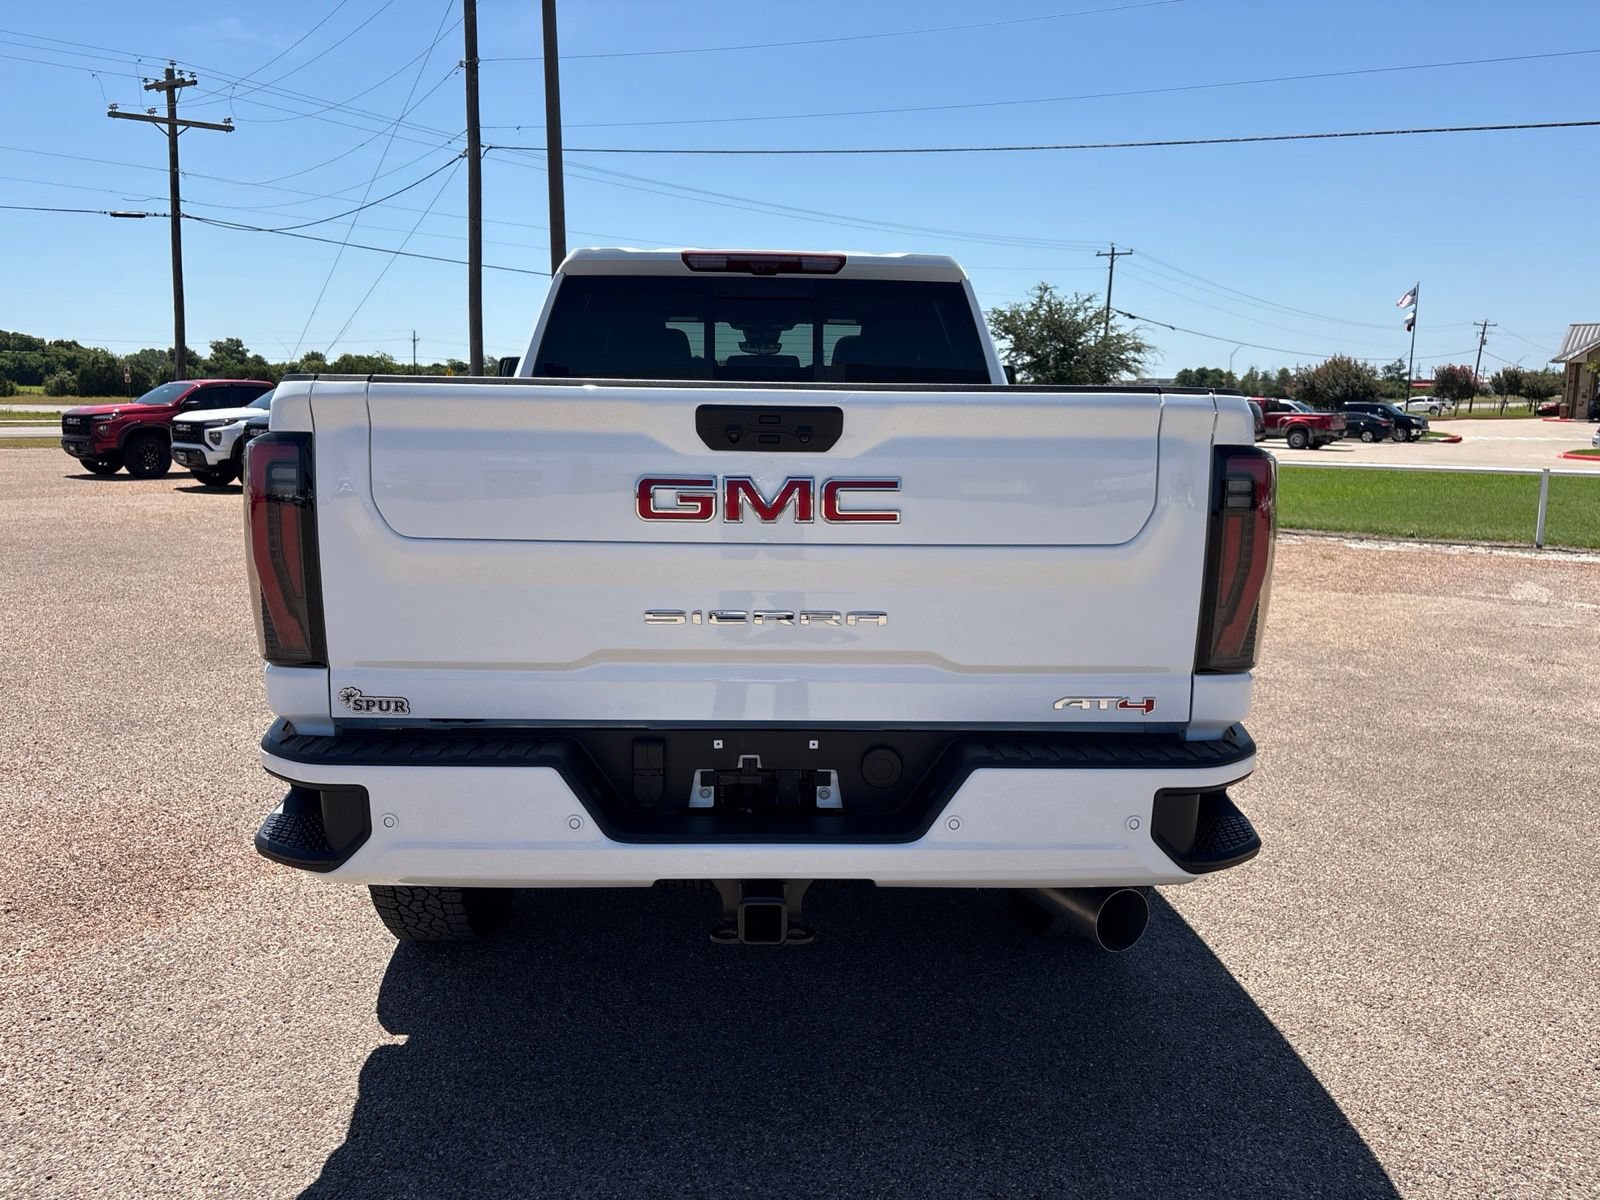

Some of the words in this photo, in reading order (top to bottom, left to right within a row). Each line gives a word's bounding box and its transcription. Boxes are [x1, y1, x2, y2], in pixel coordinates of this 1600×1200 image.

[635, 474, 902, 524] GMC
[644, 609, 888, 626] SIERRA
[353, 699, 406, 713] SPUR
[1053, 696, 1156, 715] AT4
